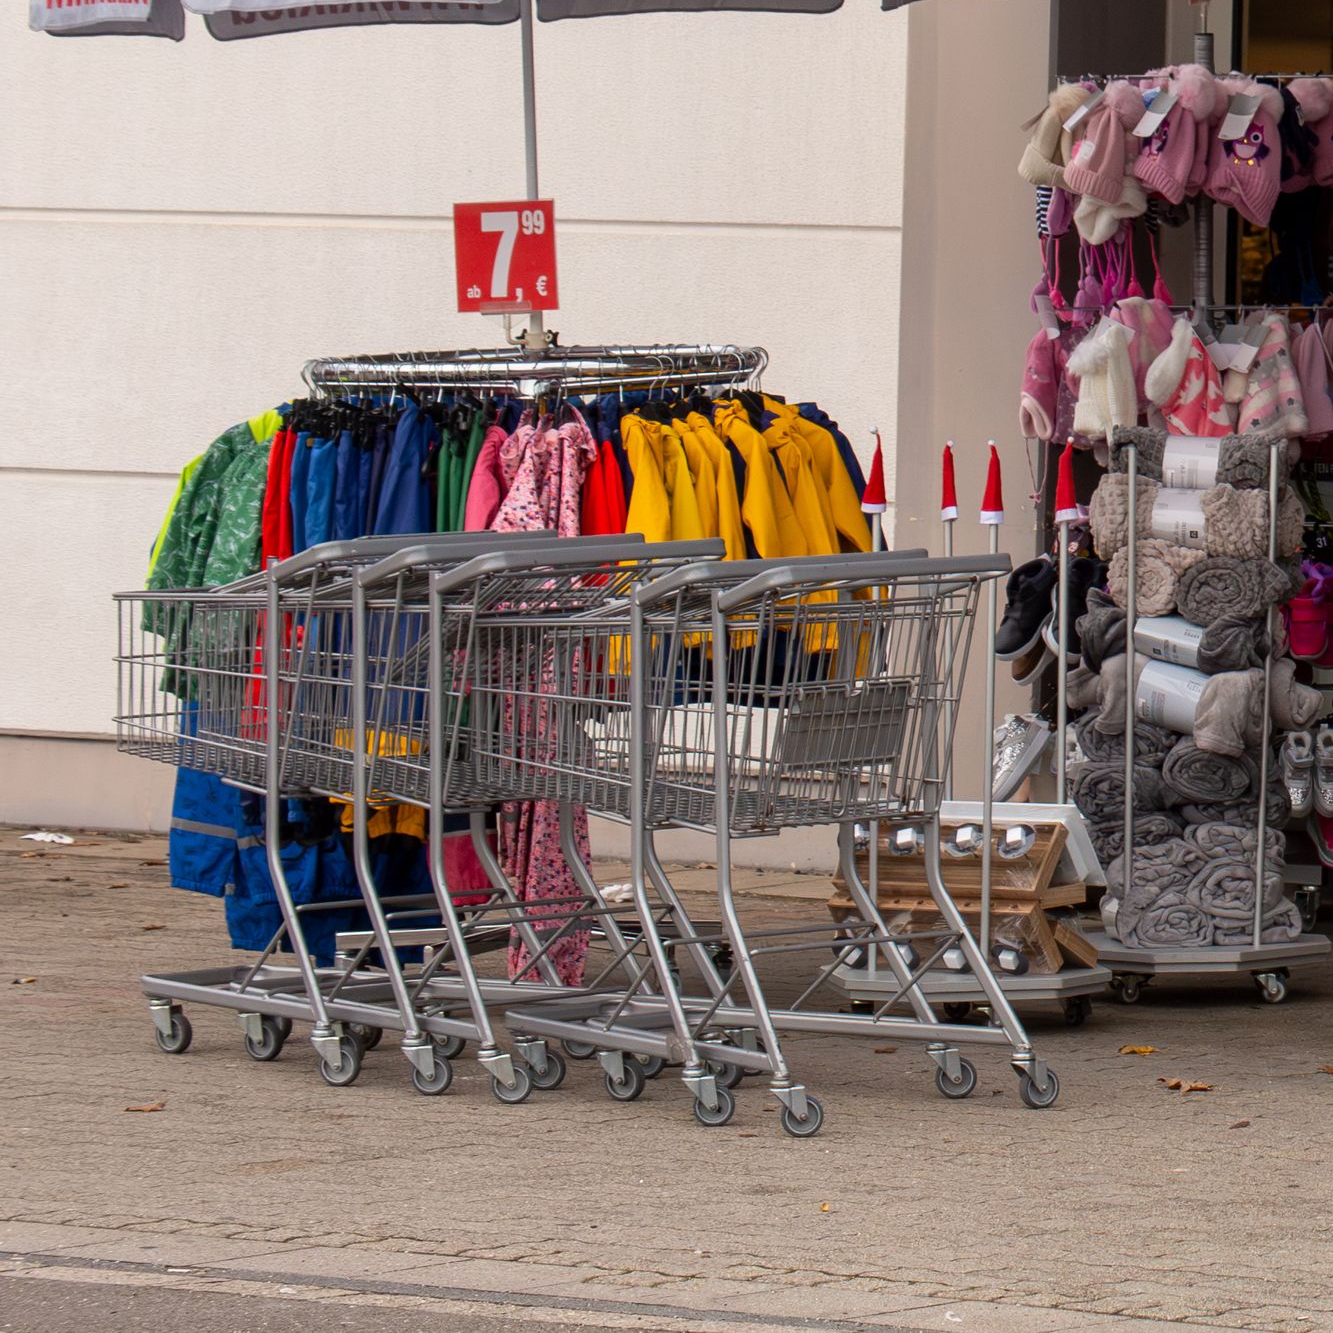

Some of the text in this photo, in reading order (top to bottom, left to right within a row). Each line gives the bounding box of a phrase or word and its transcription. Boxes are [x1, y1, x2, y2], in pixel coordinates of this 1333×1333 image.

[466, 285, 482, 300] ab
[535, 274, 549, 297] €
[1316, 537, 1327, 548] 31
